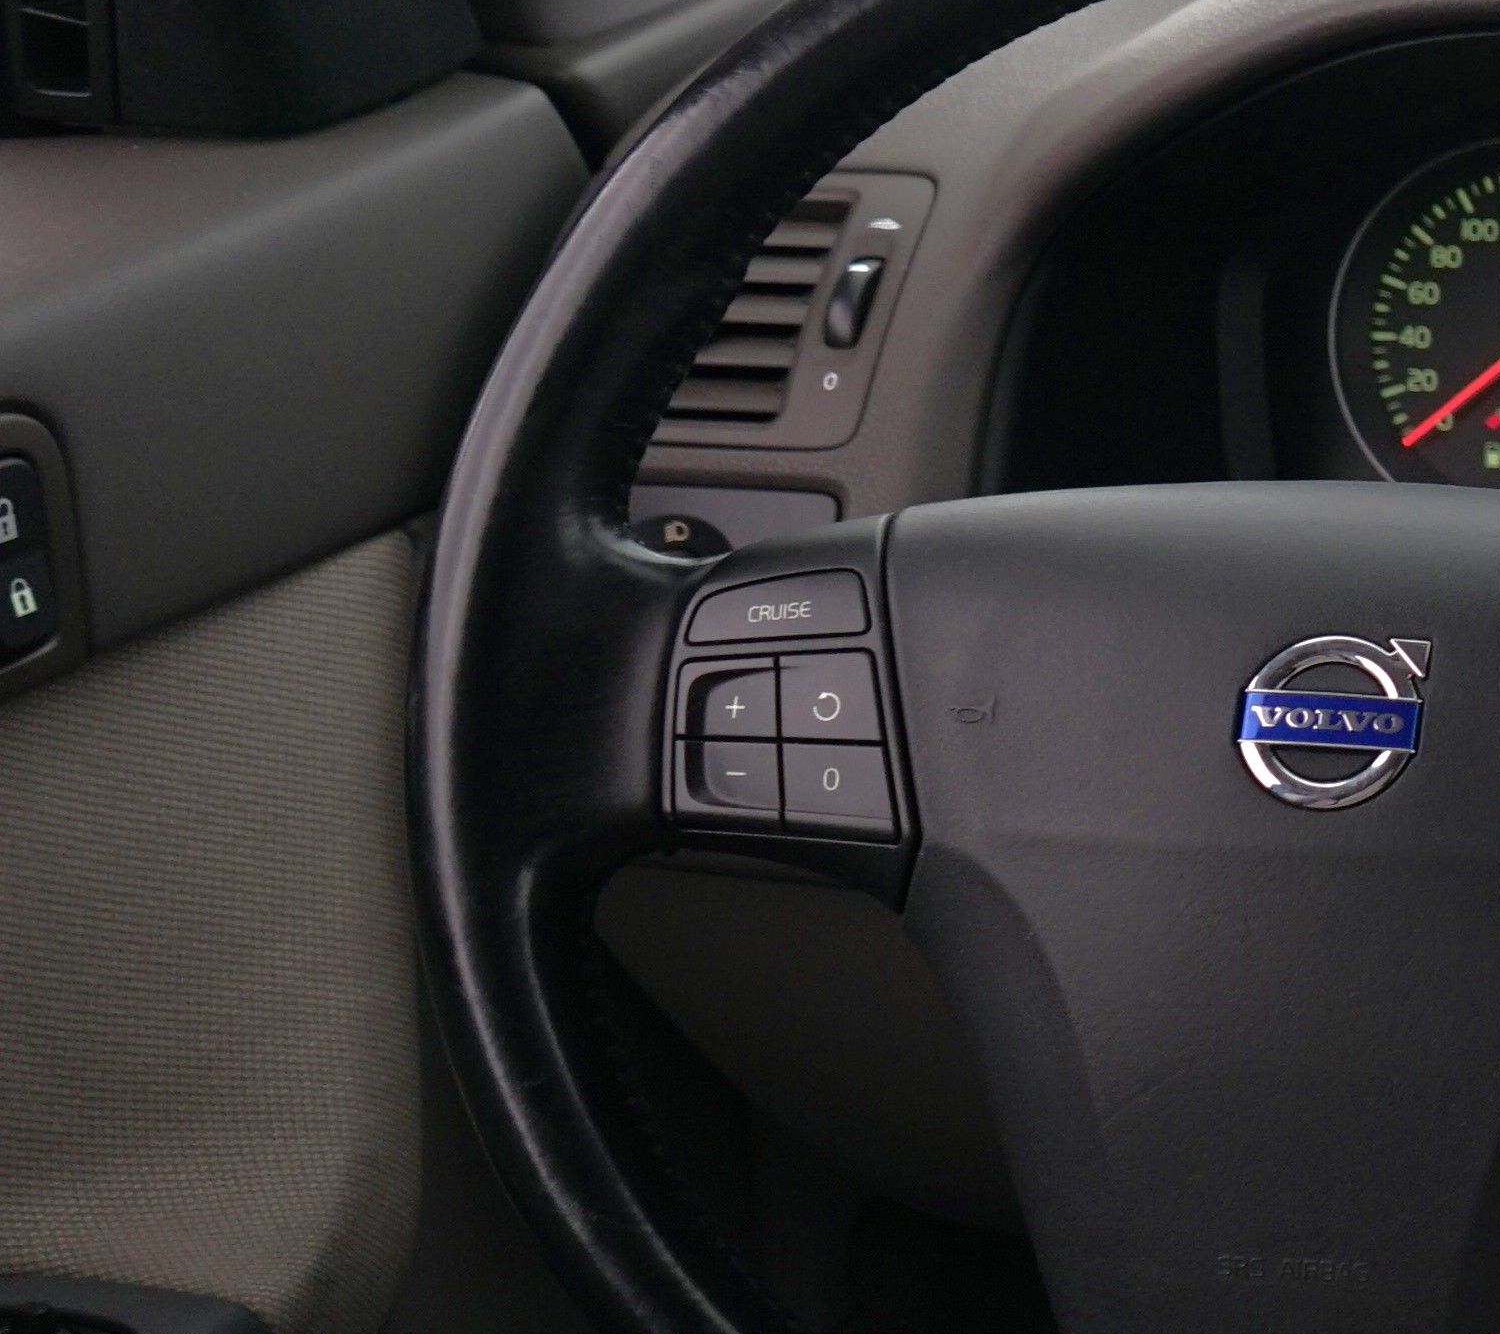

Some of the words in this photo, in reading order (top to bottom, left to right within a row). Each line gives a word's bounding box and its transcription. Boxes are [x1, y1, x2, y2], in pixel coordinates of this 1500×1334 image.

[1407, 281, 1440, 305] 60
[747, 600, 812, 623] CRUISE
[1250, 704, 1404, 735] VOLVO
[822, 767, 840, 791] 0
